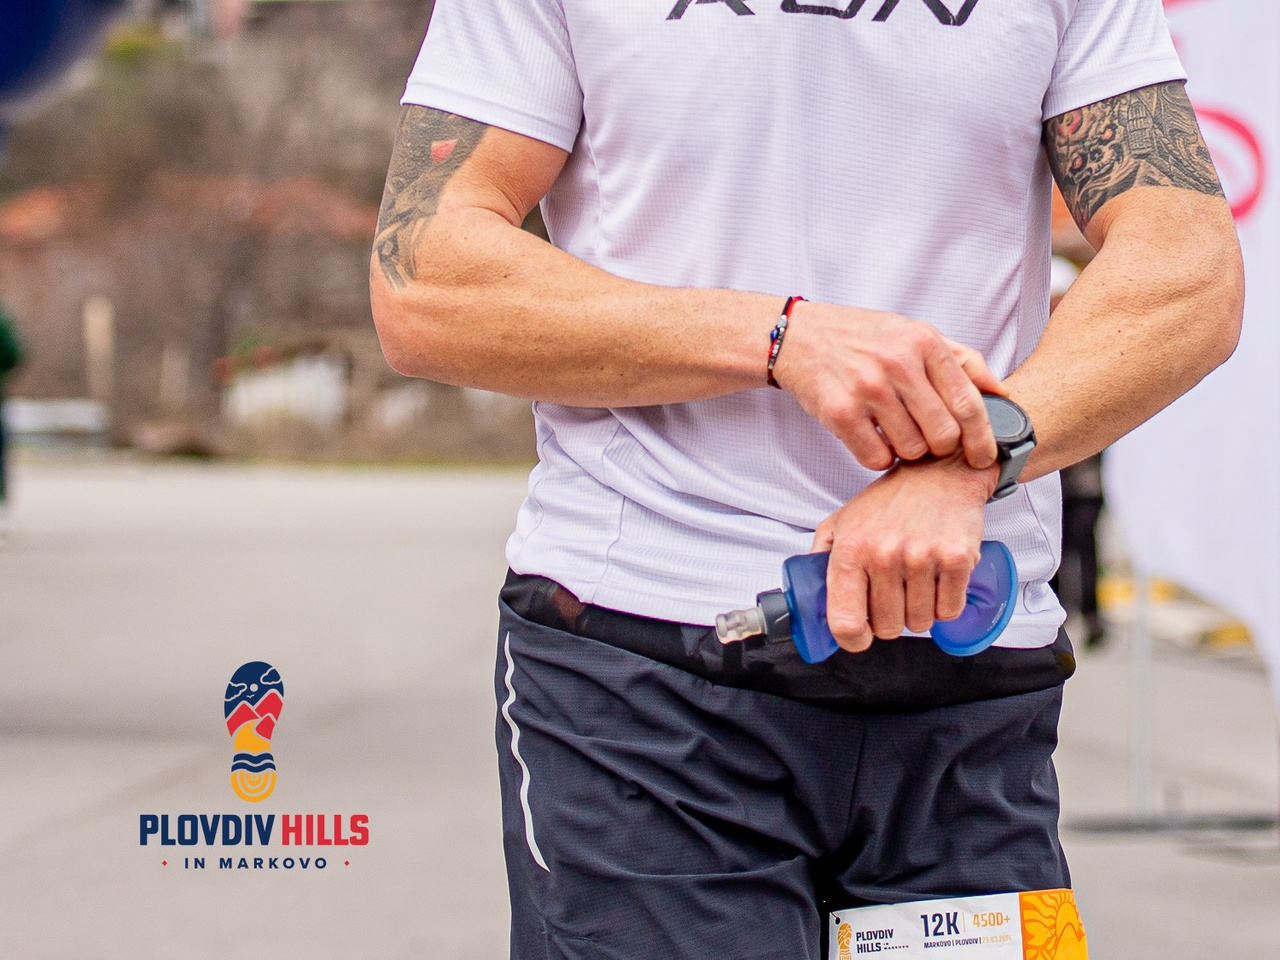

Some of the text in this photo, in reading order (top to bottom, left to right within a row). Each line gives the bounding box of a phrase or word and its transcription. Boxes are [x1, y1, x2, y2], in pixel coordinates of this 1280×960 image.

[921, 912, 1010, 937] 12K 450D+
[856, 929, 894, 942] PLOVDIV
[857, 942, 882, 954] HILLS
[924, 940, 951, 948] MARKOVO
[955, 937, 978, 946] PLOVDIV
